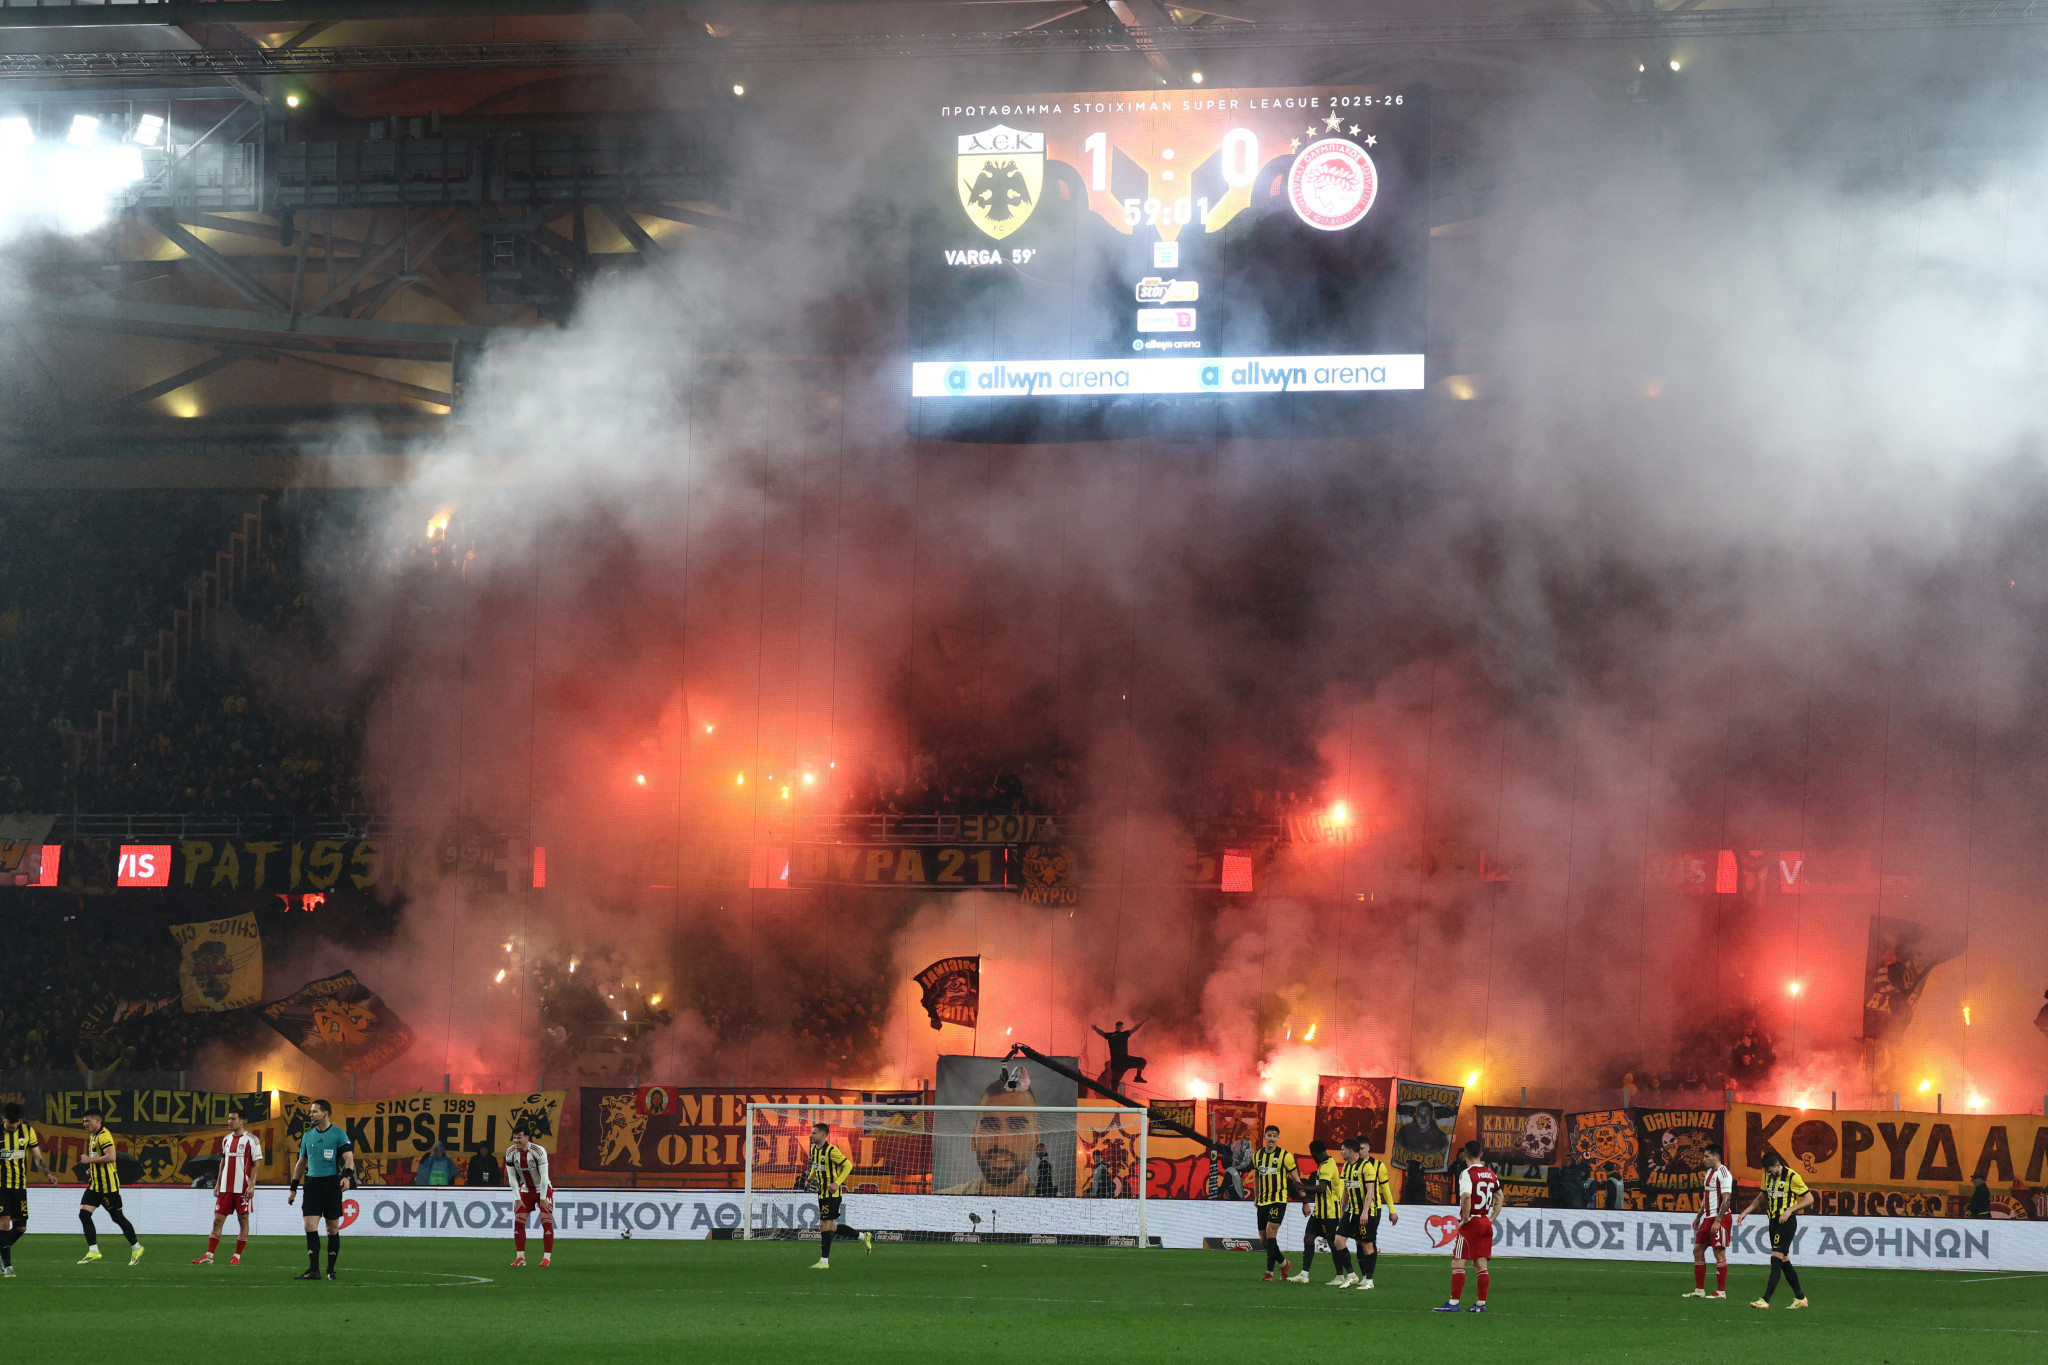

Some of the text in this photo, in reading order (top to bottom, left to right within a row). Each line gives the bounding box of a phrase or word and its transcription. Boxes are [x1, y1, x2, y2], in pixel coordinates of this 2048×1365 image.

[941, 95, 1404, 117] ΠΡΩΤΑΘΛΗΜΑ STOIXIMAN SUPER LEAGUE 2025-26
[1085, 132, 1107, 190] 1
[1222, 128, 1258, 187] 0
[1124, 197, 1209, 226] 59:01
[944, 250, 1002, 265] VARGA
[978, 365, 1051, 395] allwyn
[1060, 368, 1129, 387] arena
[1231, 362, 1306, 391] allwyn
[1314, 365, 1386, 384] arena
[938, 849, 991, 883] 21
[376, 1098, 475, 1113] SINCE 1989
[678, 1094, 857, 1127] MENIDI
[1643, 1112, 1717, 1132] ORIGINAL
[1474, 1181, 1495, 1210] 56
[373, 1200, 513, 1229] ΟΜΙΛΟΣ
[1774, 1234, 1780, 1244] 8
[1817, 1227, 1989, 1259] ΑΘΗΝΩΝ
